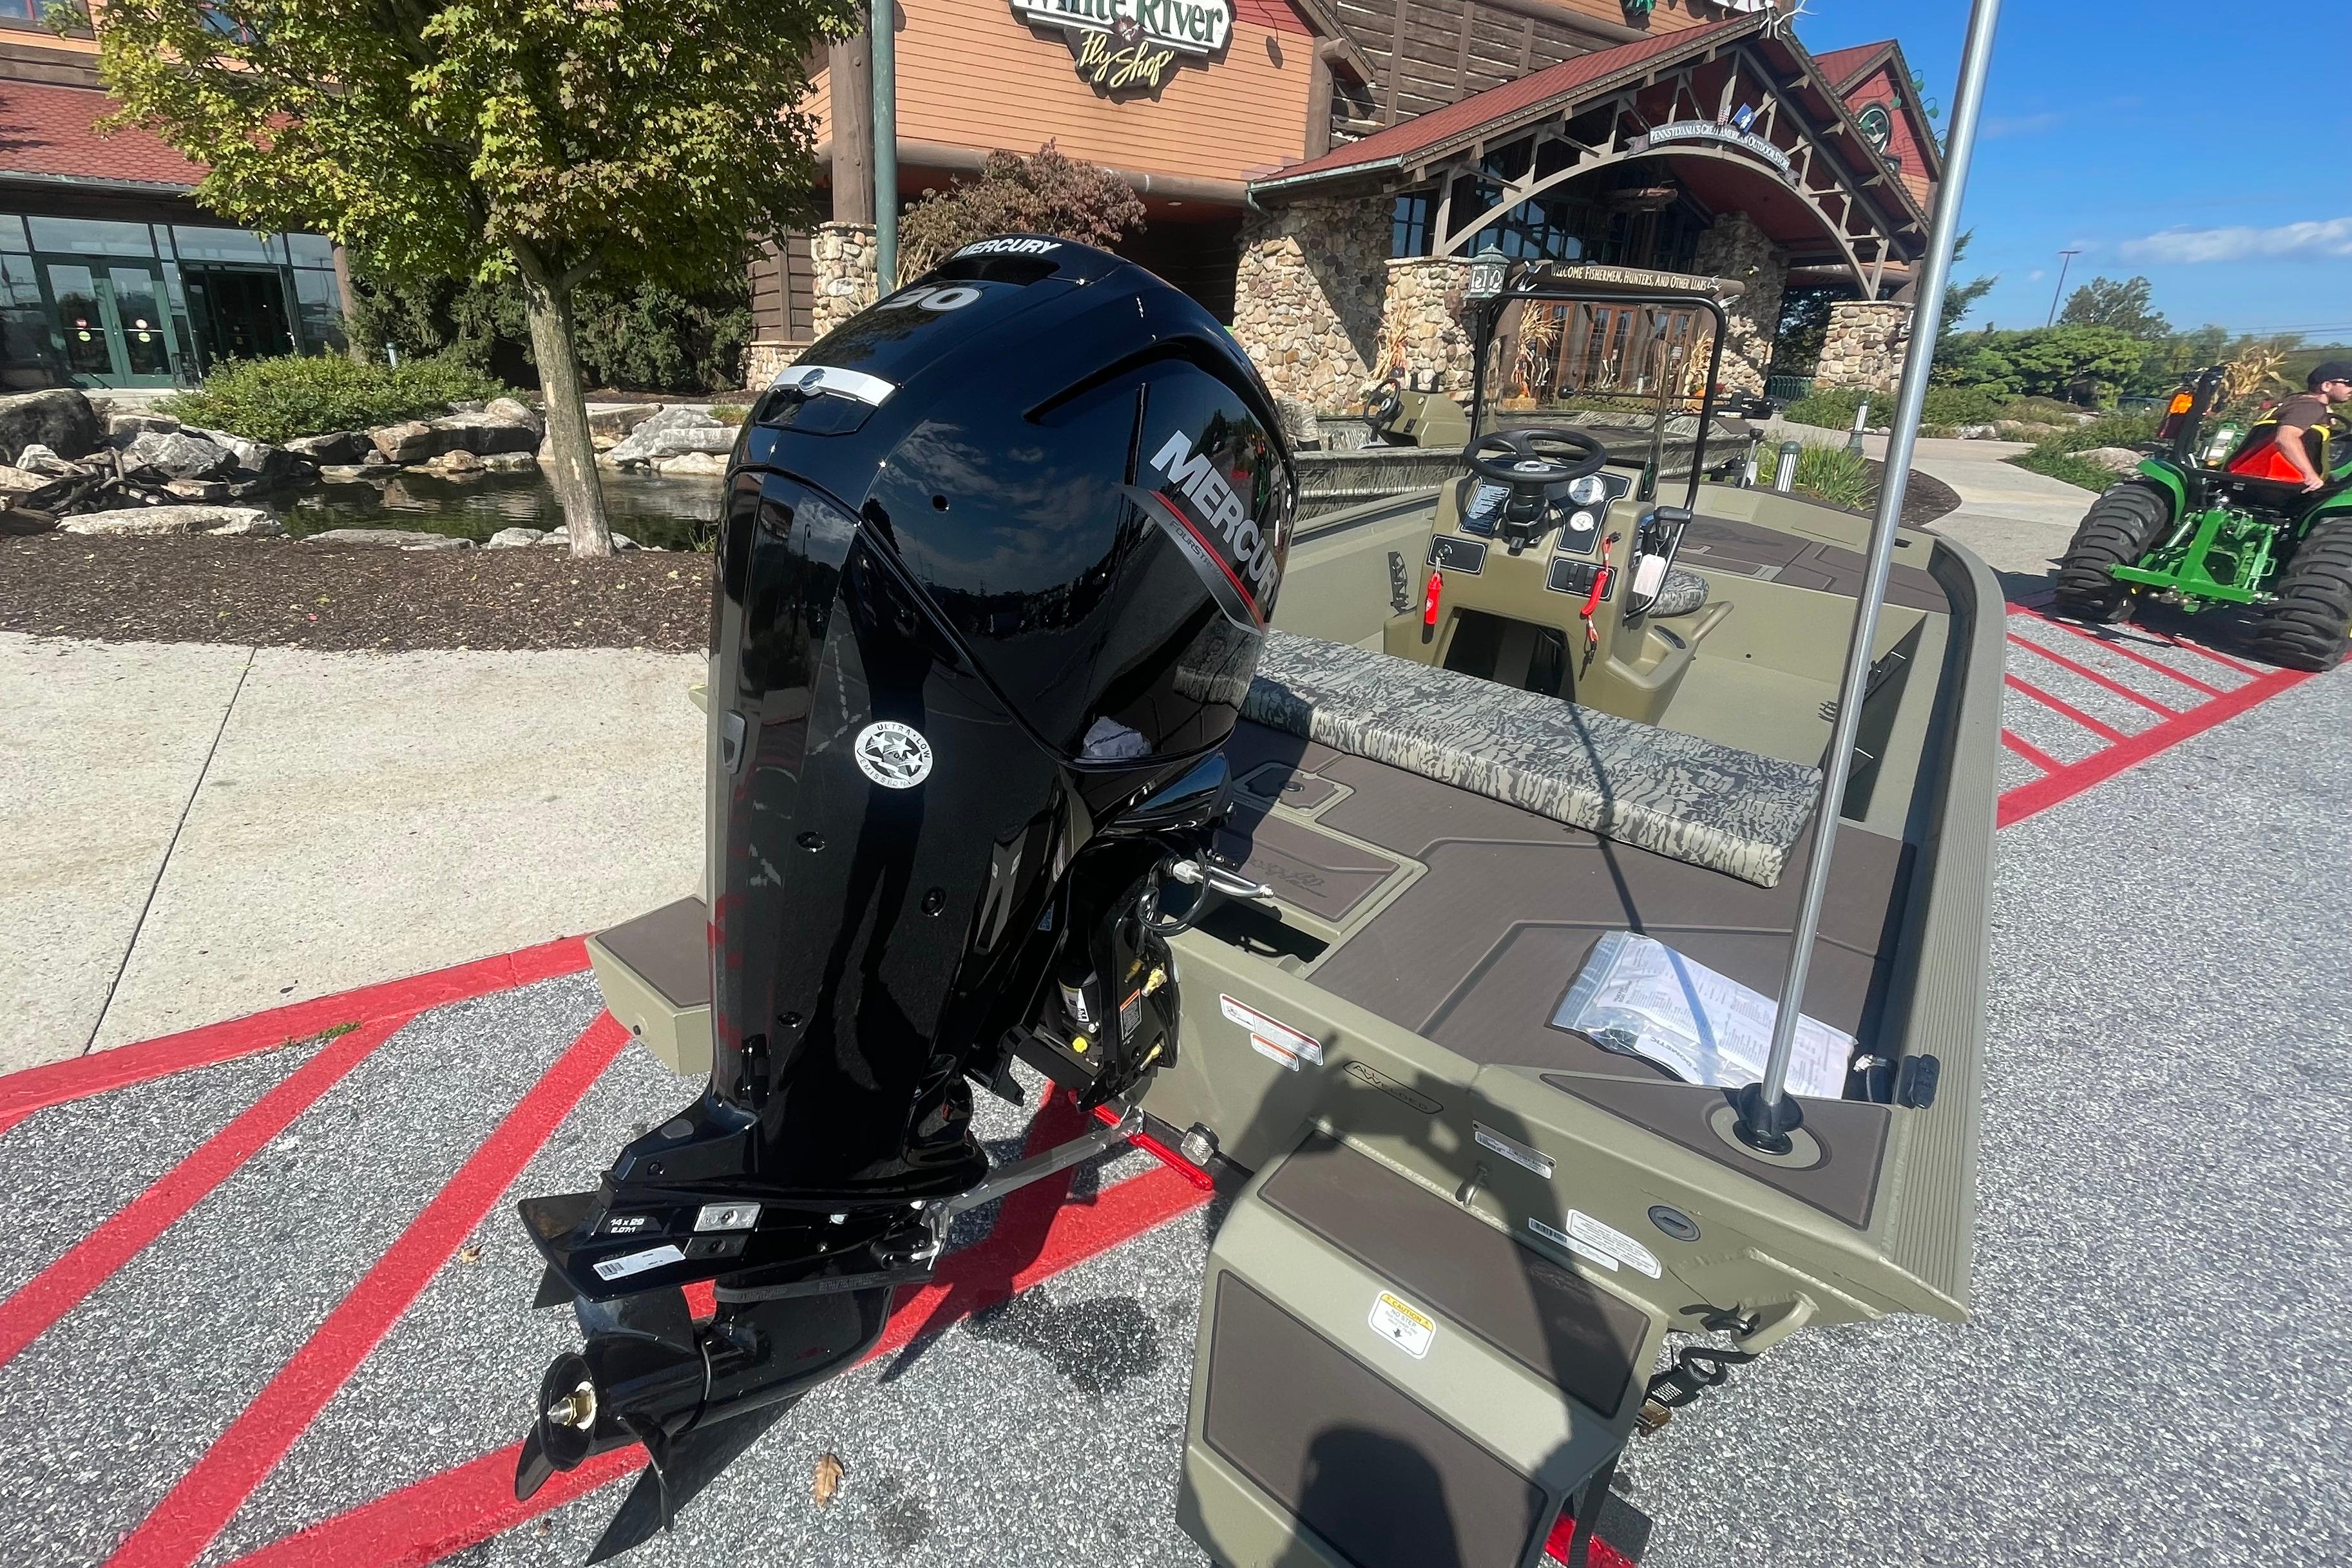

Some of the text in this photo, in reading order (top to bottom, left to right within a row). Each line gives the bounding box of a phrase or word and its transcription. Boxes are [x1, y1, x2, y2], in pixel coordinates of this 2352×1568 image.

[1136, 0, 1223, 43] River
[1080, 29, 1175, 88] Fly Shop
[1748, 136, 1775, 158] OUTDOOR
[1774, 151, 1790, 171] STORE
[951, 238, 1063, 259] MERCURY
[1551, 263, 1707, 291] WELCOME FISHERMEN, HUNTERS, AND OTHER LIARS
[877, 723, 930, 758] ULTRA LOW
[860, 759, 906, 787] EMISSION
[1650, 1037, 1692, 1067] DOMETIC
[1391, 1309, 1401, 1317] NO
[1392, 1301, 1422, 1323] CAUTION
